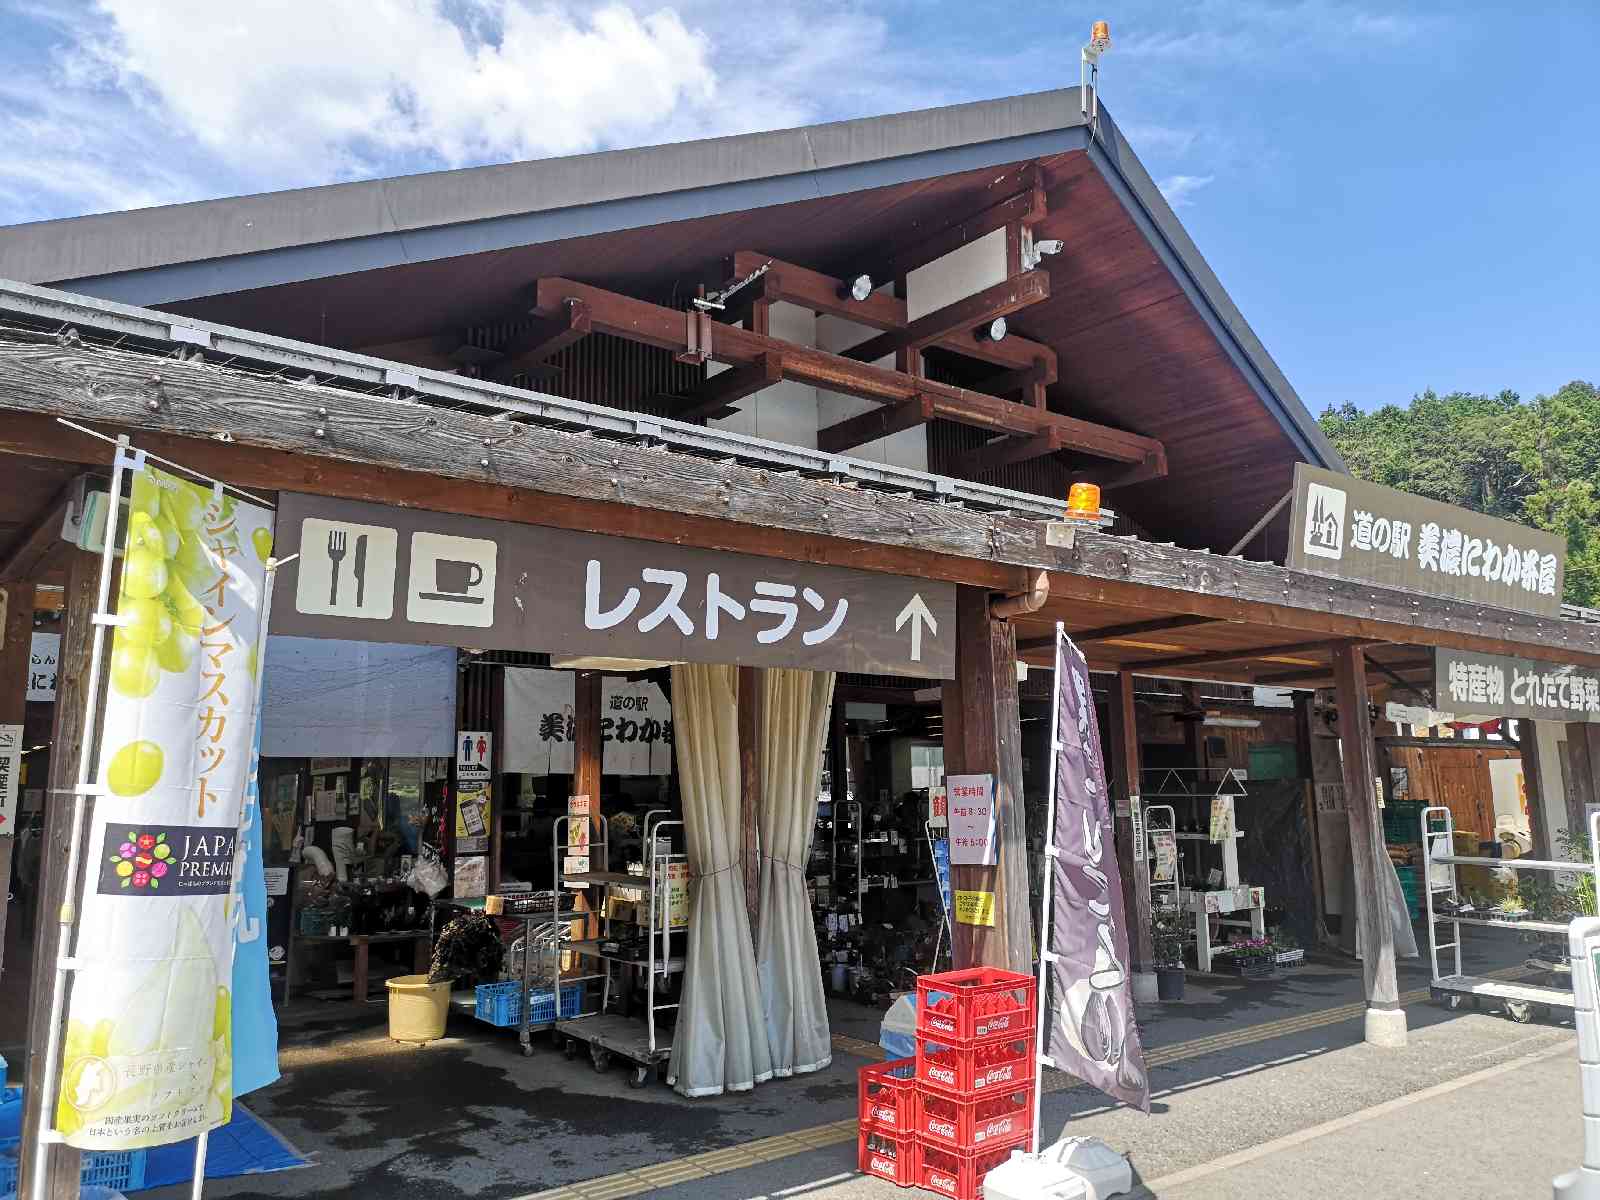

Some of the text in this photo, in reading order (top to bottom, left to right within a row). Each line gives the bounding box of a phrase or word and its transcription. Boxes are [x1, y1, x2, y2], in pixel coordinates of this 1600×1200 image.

[1352, 510, 1557, 596] 道の駅 美濃にわか茶屋
[585, 559, 849, 646] レストラン
[194, 503, 237, 818] シャインマスカット
[609, 695, 649, 712] 道の駅
[1449, 661, 1600, 712] 特産物 とれたて野菜
[928, 1066, 954, 1084] Coca-Cola
[986, 1065, 1012, 1084] Coca-Cola
